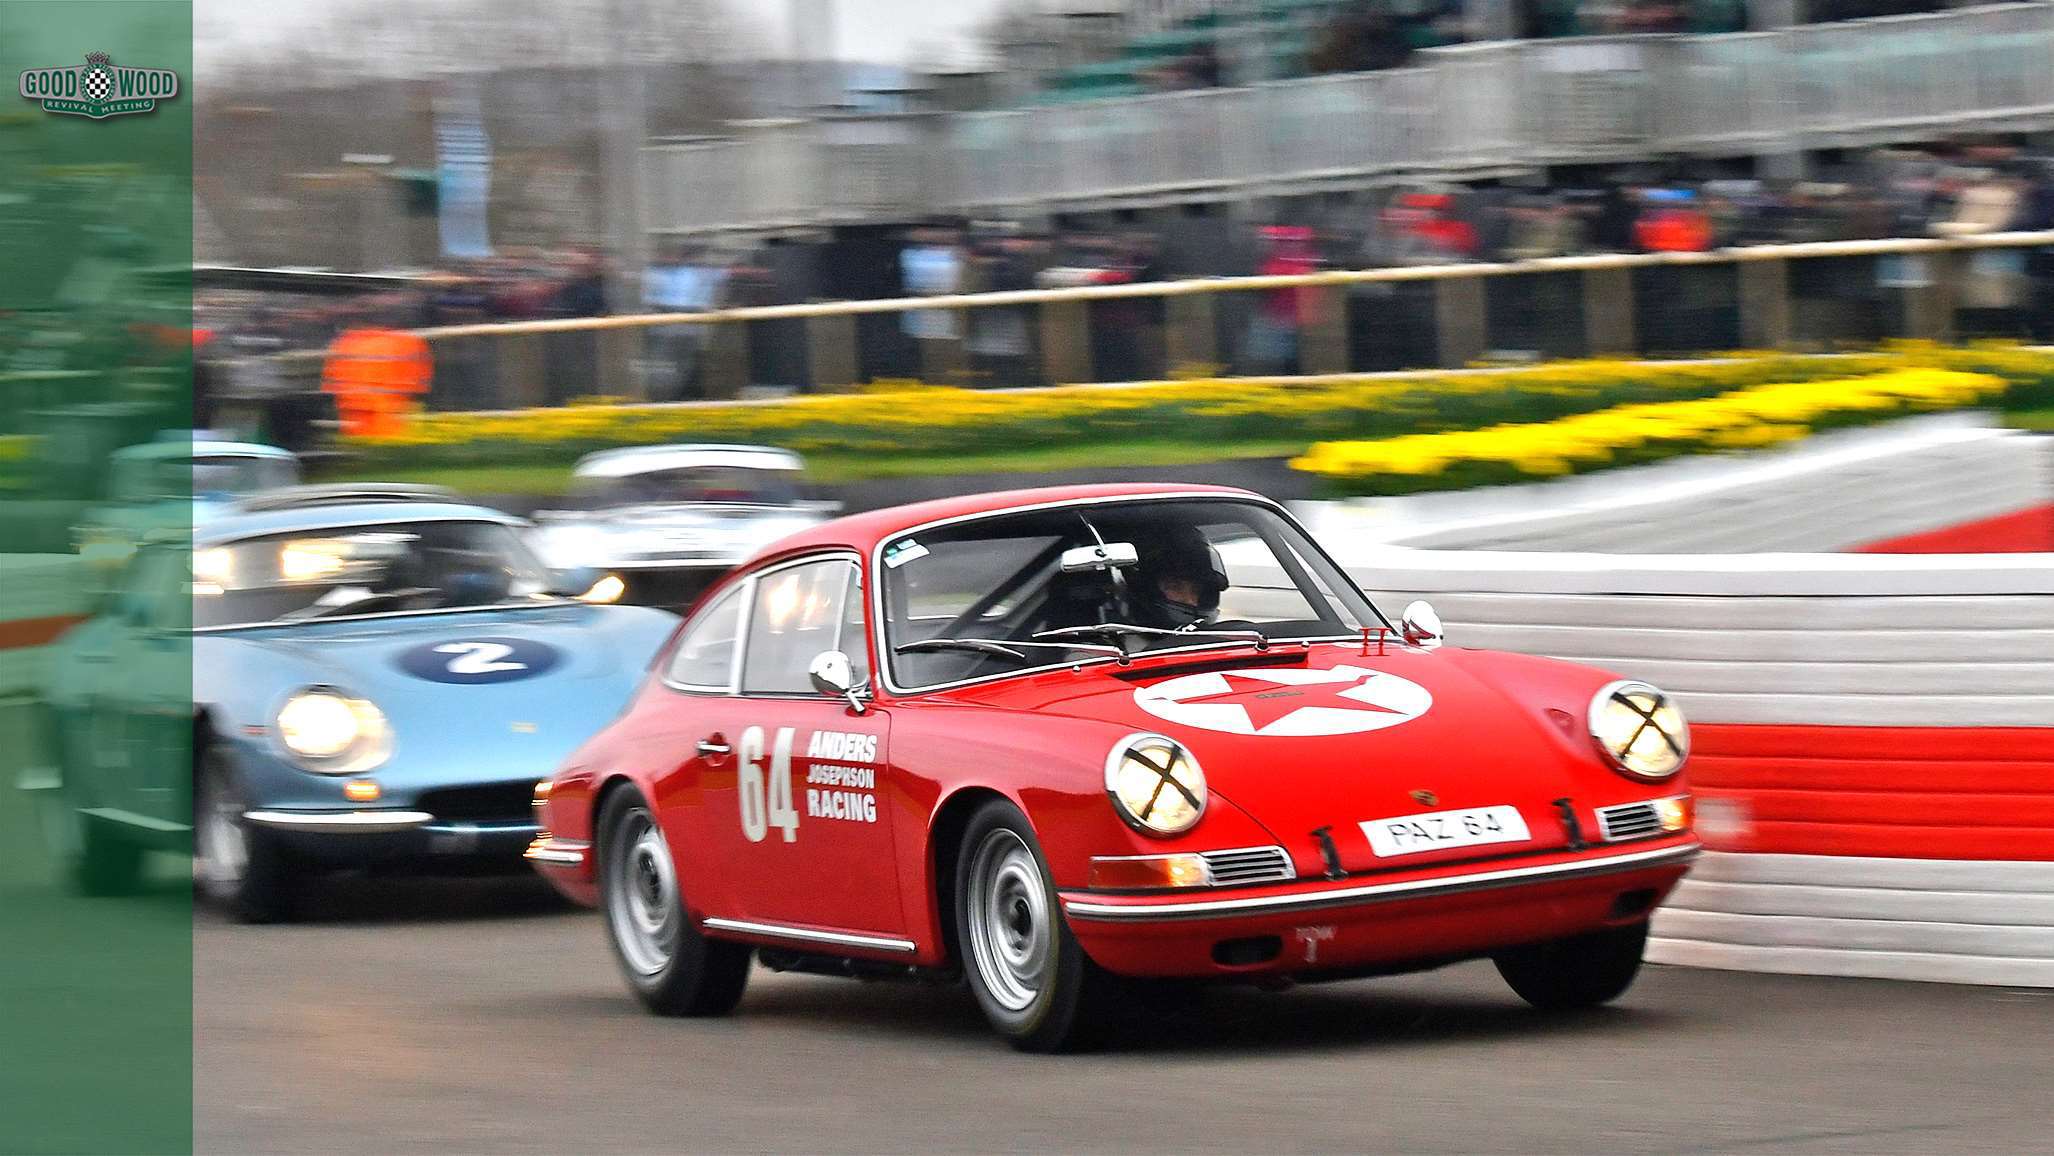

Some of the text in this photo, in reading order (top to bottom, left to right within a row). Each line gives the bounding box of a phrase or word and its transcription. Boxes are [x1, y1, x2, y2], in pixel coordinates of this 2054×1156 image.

[432, 641, 528, 674] 2
[807, 730, 877, 763] ANDERS
[738, 725, 799, 843] 64
[806, 763, 875, 789] JOSEPHSON
[806, 788, 877, 823] RACING
[1386, 813, 1503, 846] PAZ 64
